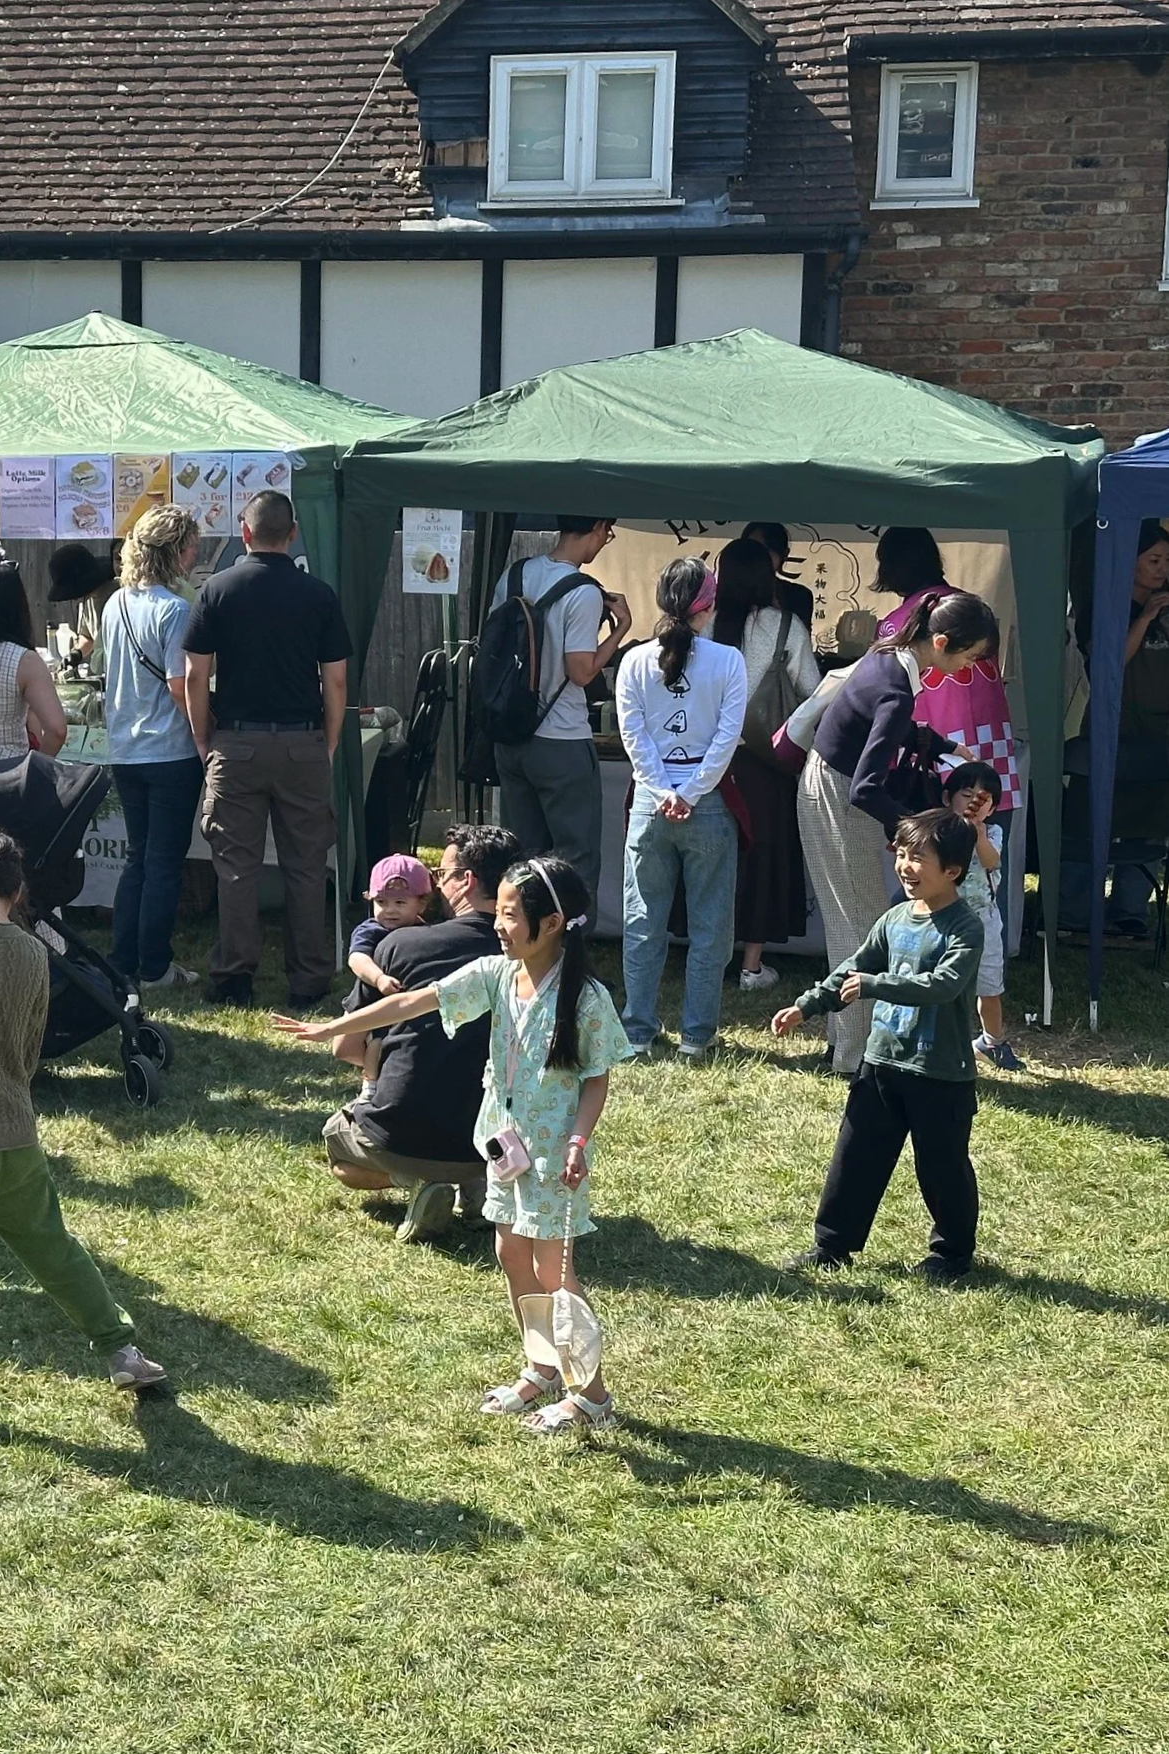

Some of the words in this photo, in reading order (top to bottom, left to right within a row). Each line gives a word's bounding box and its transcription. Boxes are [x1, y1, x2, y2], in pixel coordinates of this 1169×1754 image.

[11, 475, 41, 484] Options
[200, 492, 207, 501] 3
[210, 492, 228, 501] for
